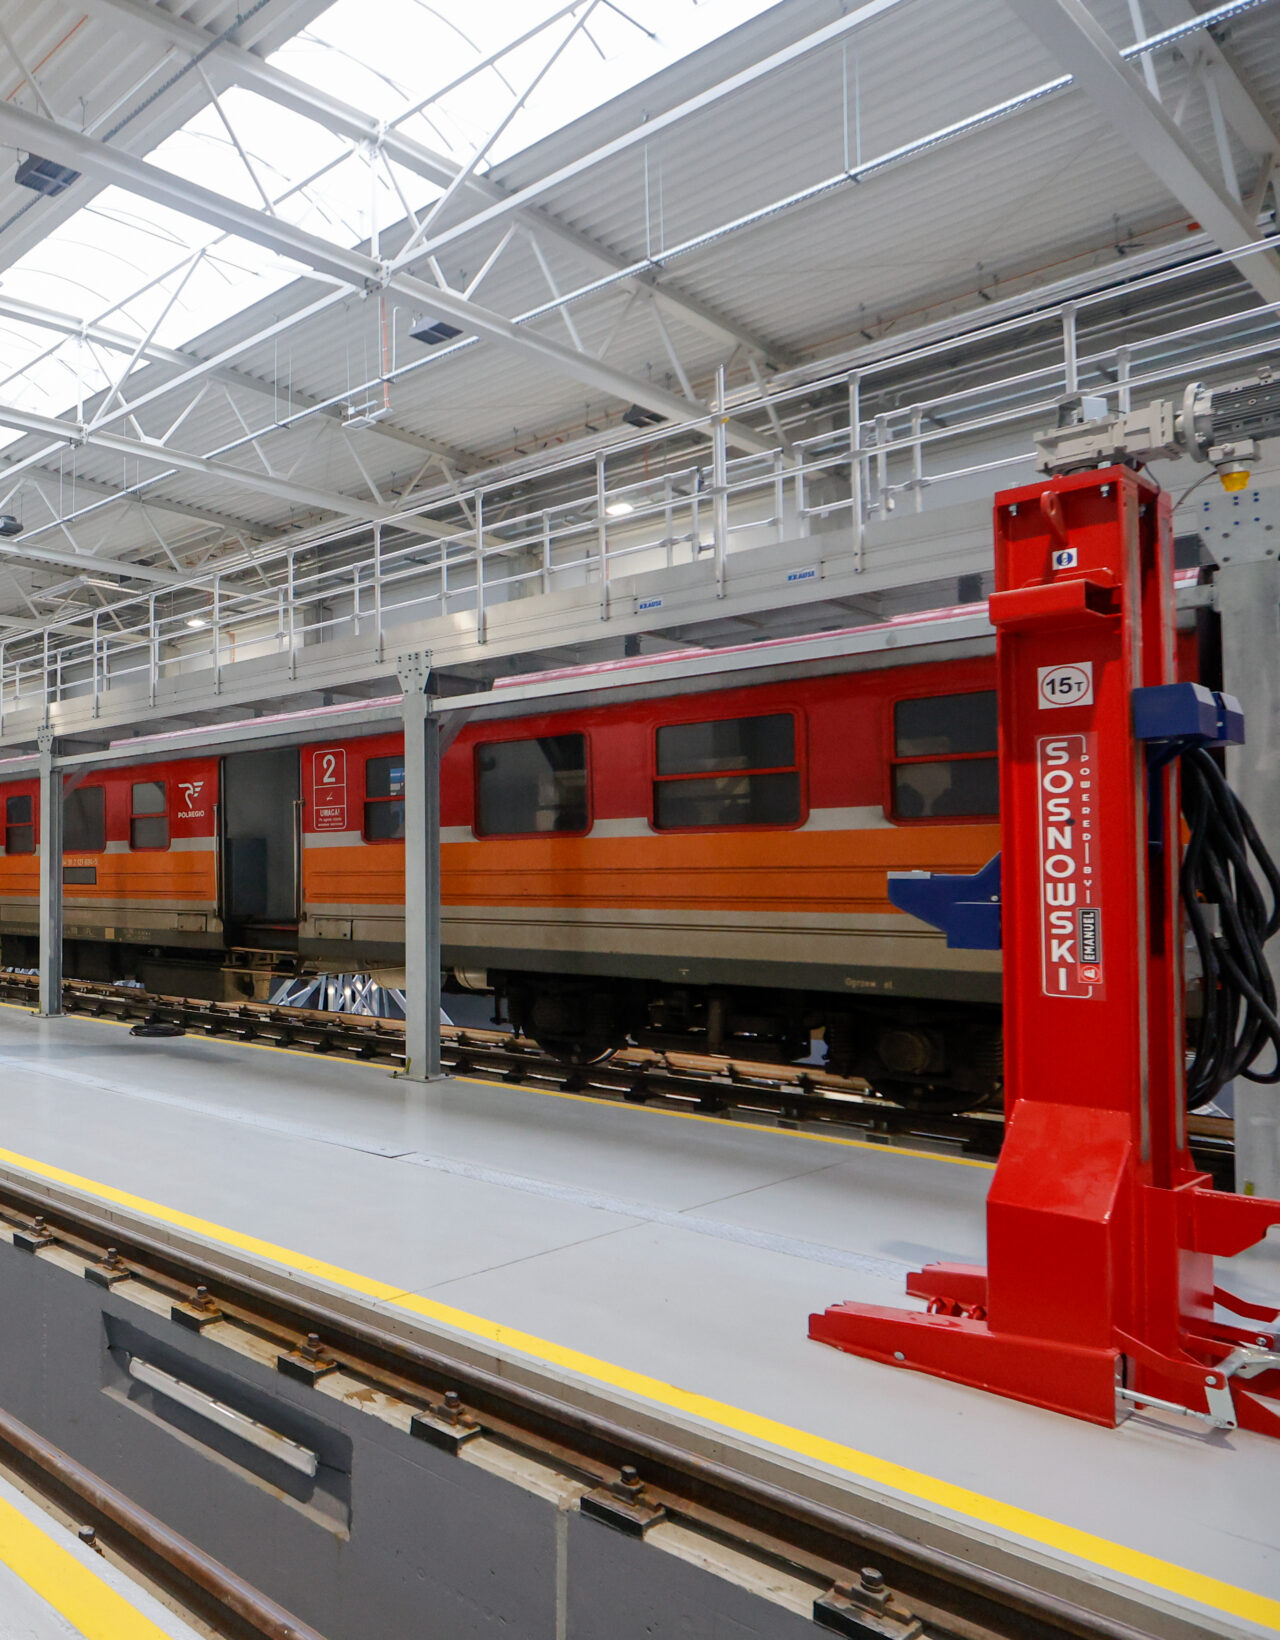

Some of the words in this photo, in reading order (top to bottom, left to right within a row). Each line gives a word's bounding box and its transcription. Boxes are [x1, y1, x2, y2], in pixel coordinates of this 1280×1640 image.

[322, 754, 336, 783] 2
[177, 810, 205, 819] POLREGIO
[1079, 754, 1092, 841] POWERED
[1042, 741, 1077, 992] SOSNOWSKI
[1082, 866, 1093, 888] BY
[1082, 911, 1096, 961] EMANUEL
